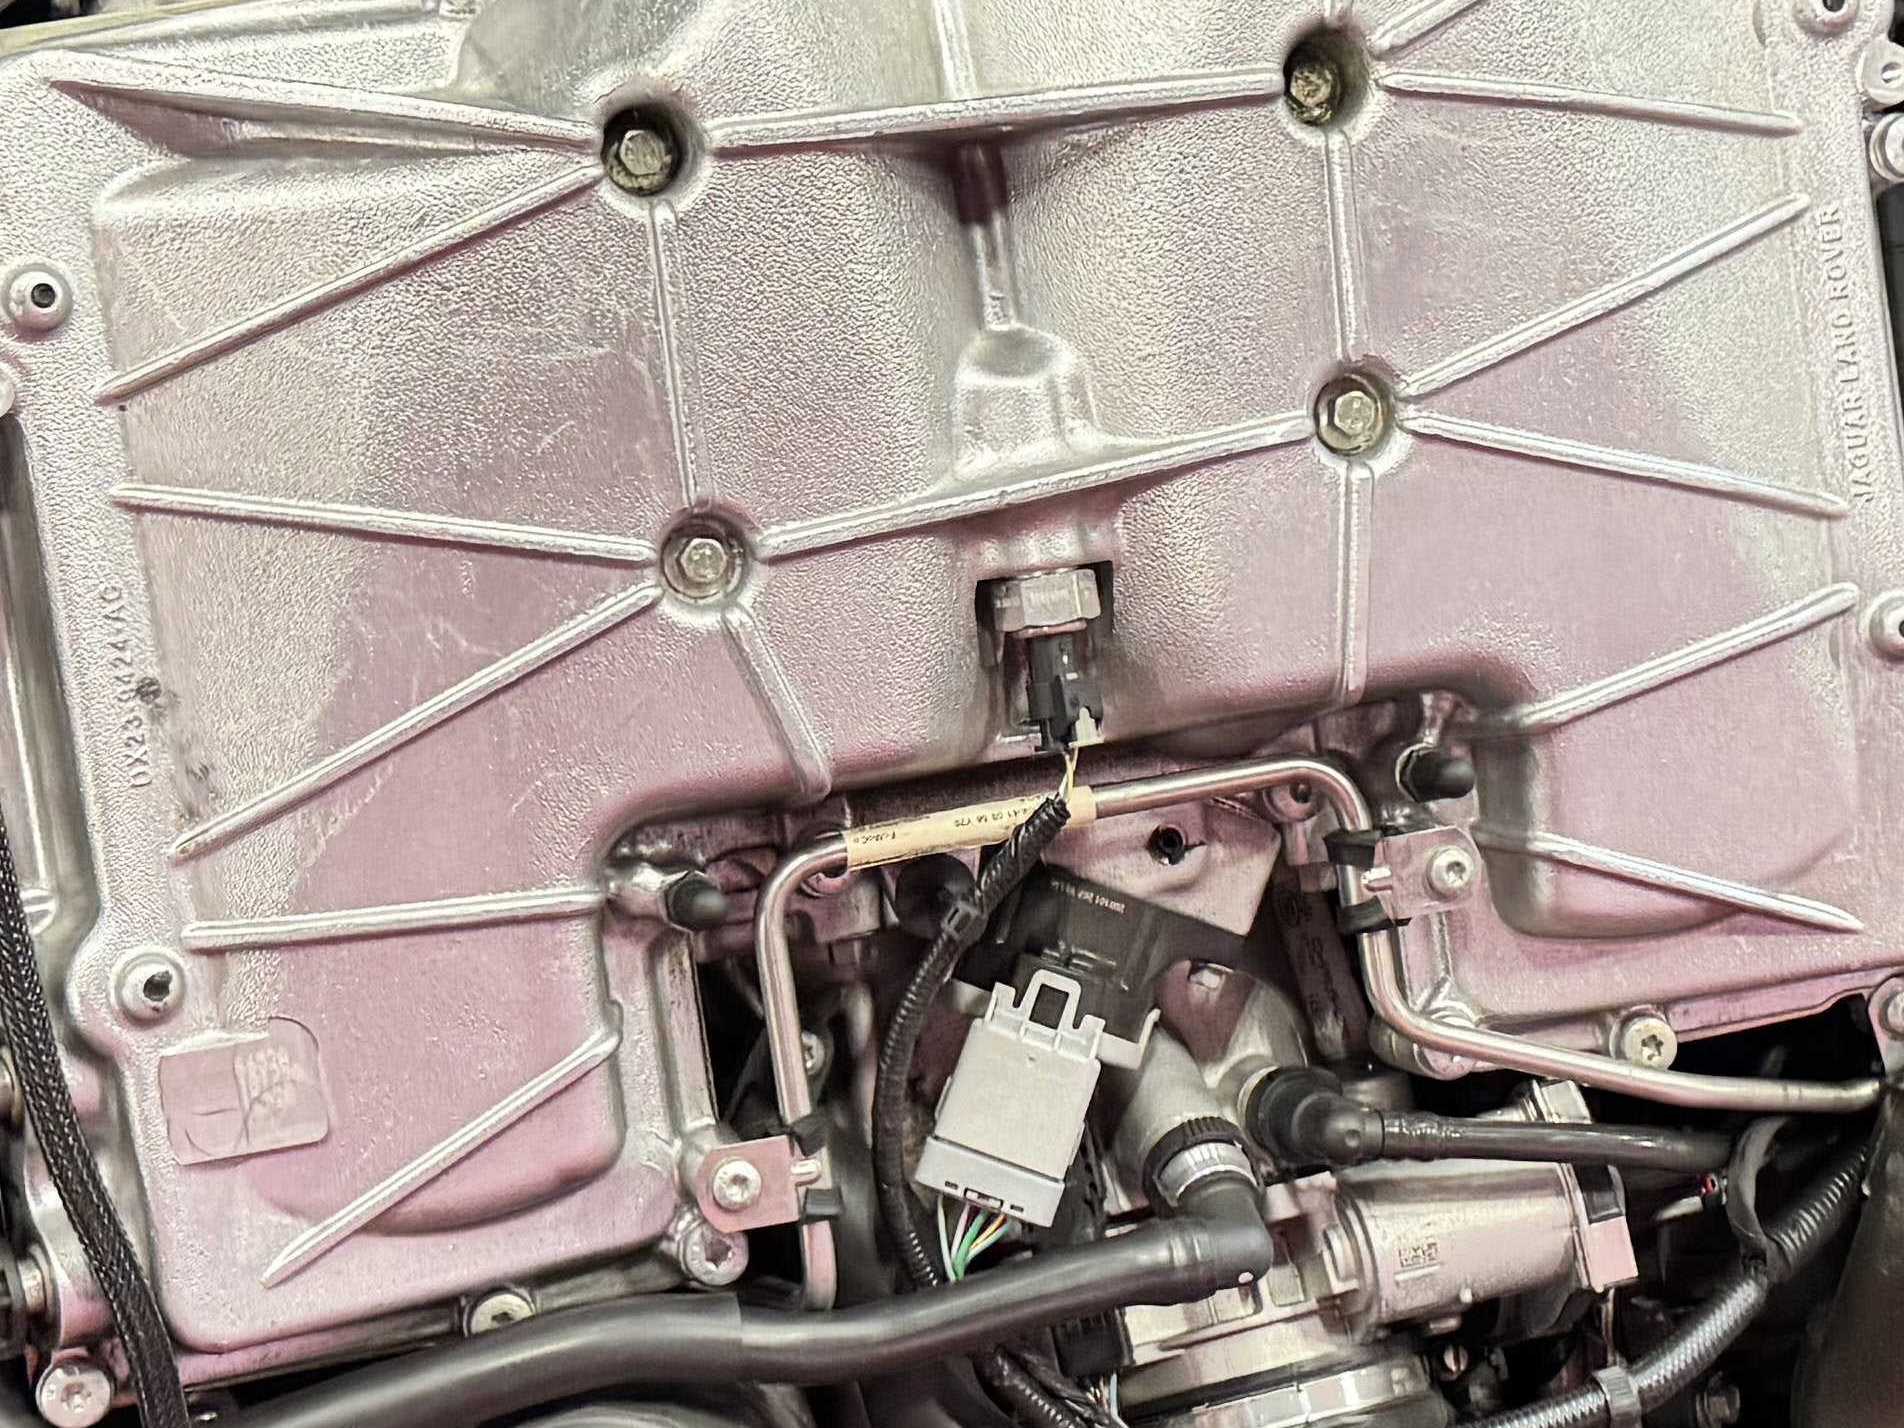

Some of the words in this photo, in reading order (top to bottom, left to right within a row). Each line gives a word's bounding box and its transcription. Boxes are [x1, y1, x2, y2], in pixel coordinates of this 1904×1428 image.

[1818, 205, 1850, 301] ROVER
[1831, 313, 1860, 384] LAND
[1843, 395, 1874, 502] JAGUAR
